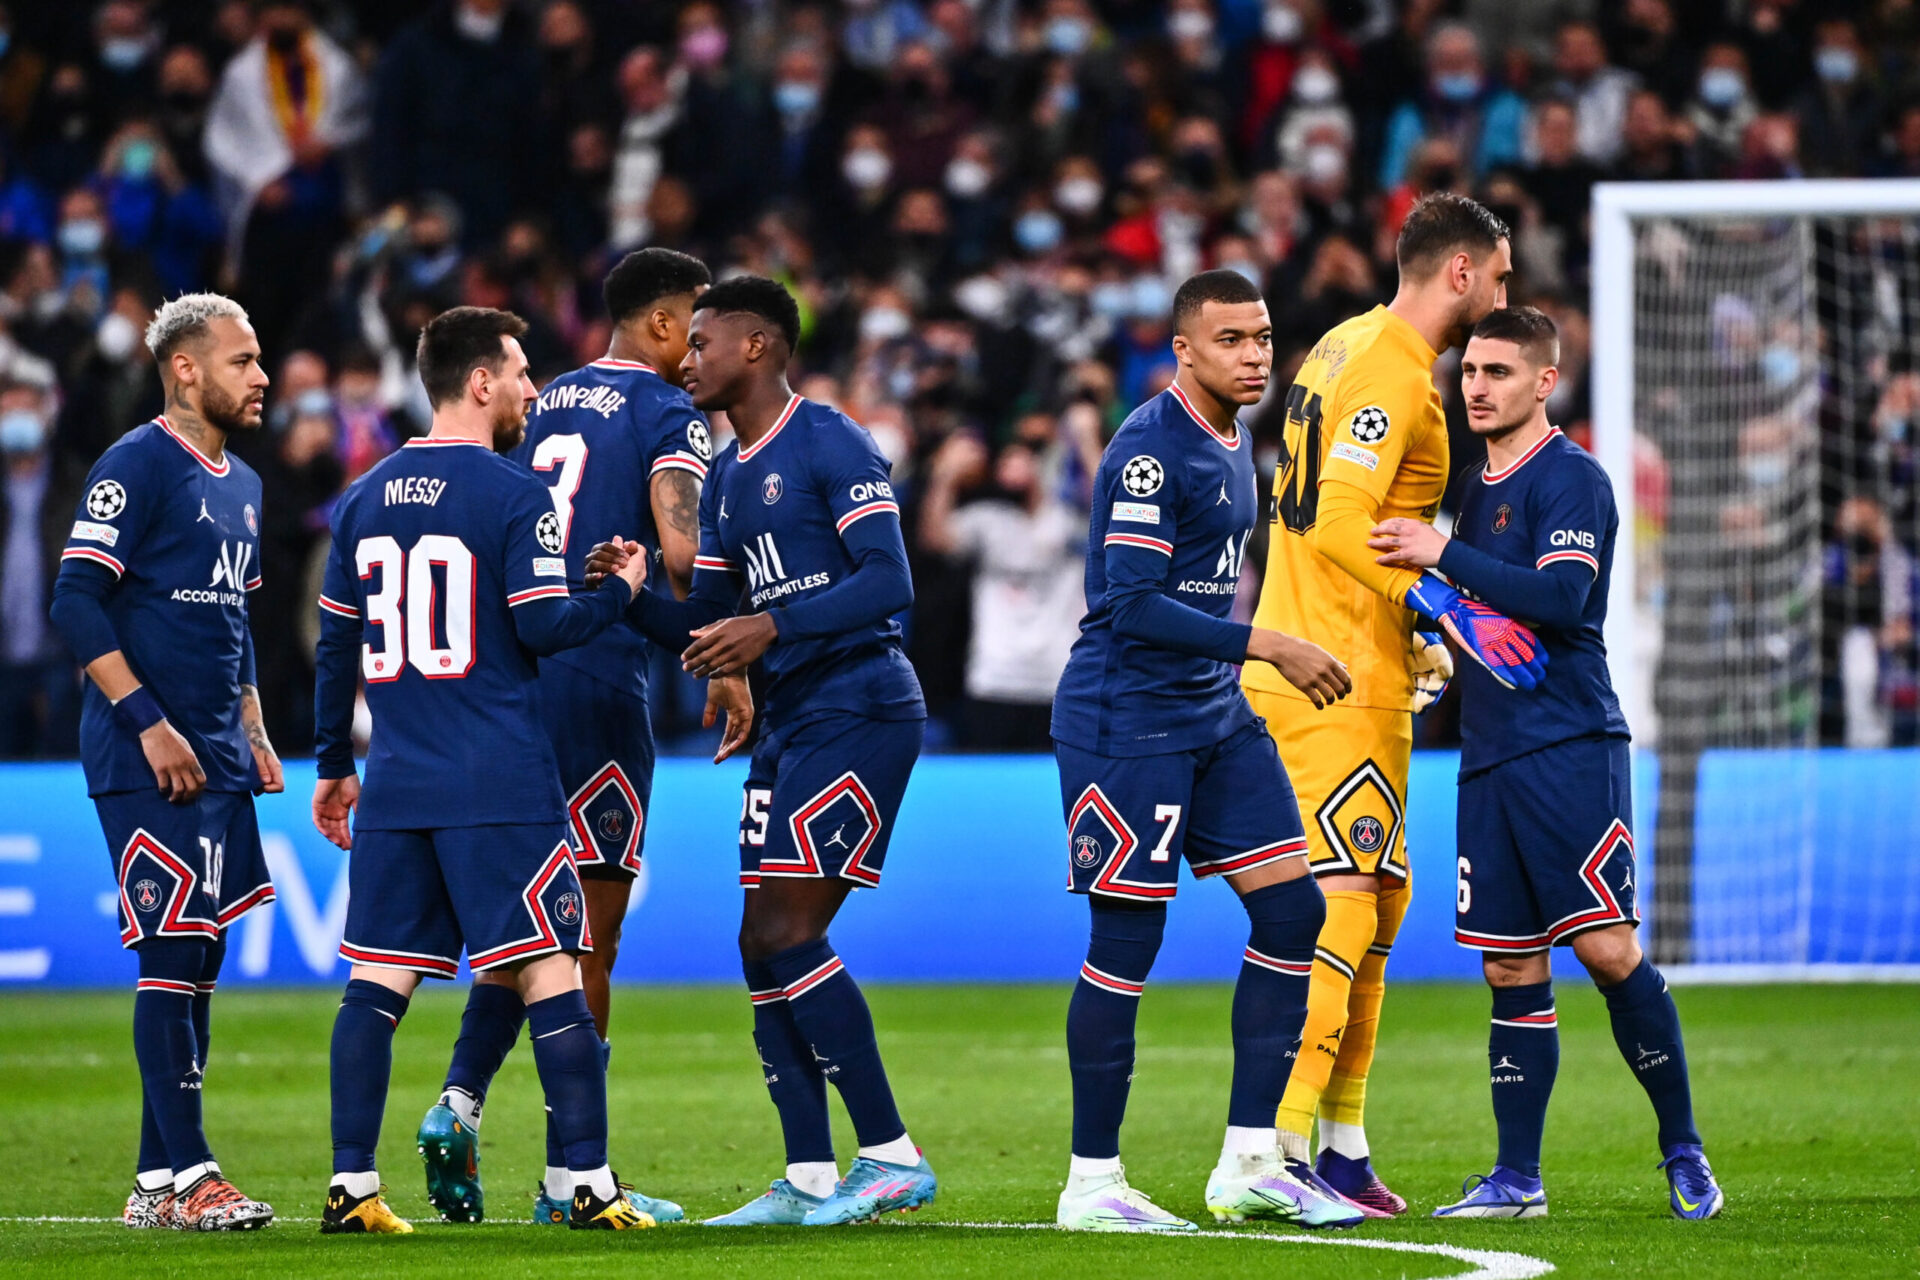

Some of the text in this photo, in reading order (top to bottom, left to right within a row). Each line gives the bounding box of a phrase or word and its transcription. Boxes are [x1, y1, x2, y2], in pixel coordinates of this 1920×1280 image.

[536, 384, 626, 419] KIMPEMBE
[385, 477, 447, 507] MESSI
[850, 482, 892, 502] QNB
[1550, 529, 1596, 549] QNB
[171, 588, 218, 604] ACCOR
[1177, 580, 1219, 595] ACCOR
[355, 534, 477, 683] 30
[1151, 804, 1181, 862] 7
[199, 836, 223, 900] 10
[1457, 855, 1472, 915] 6
[1490, 1074, 1525, 1084] PARIS
